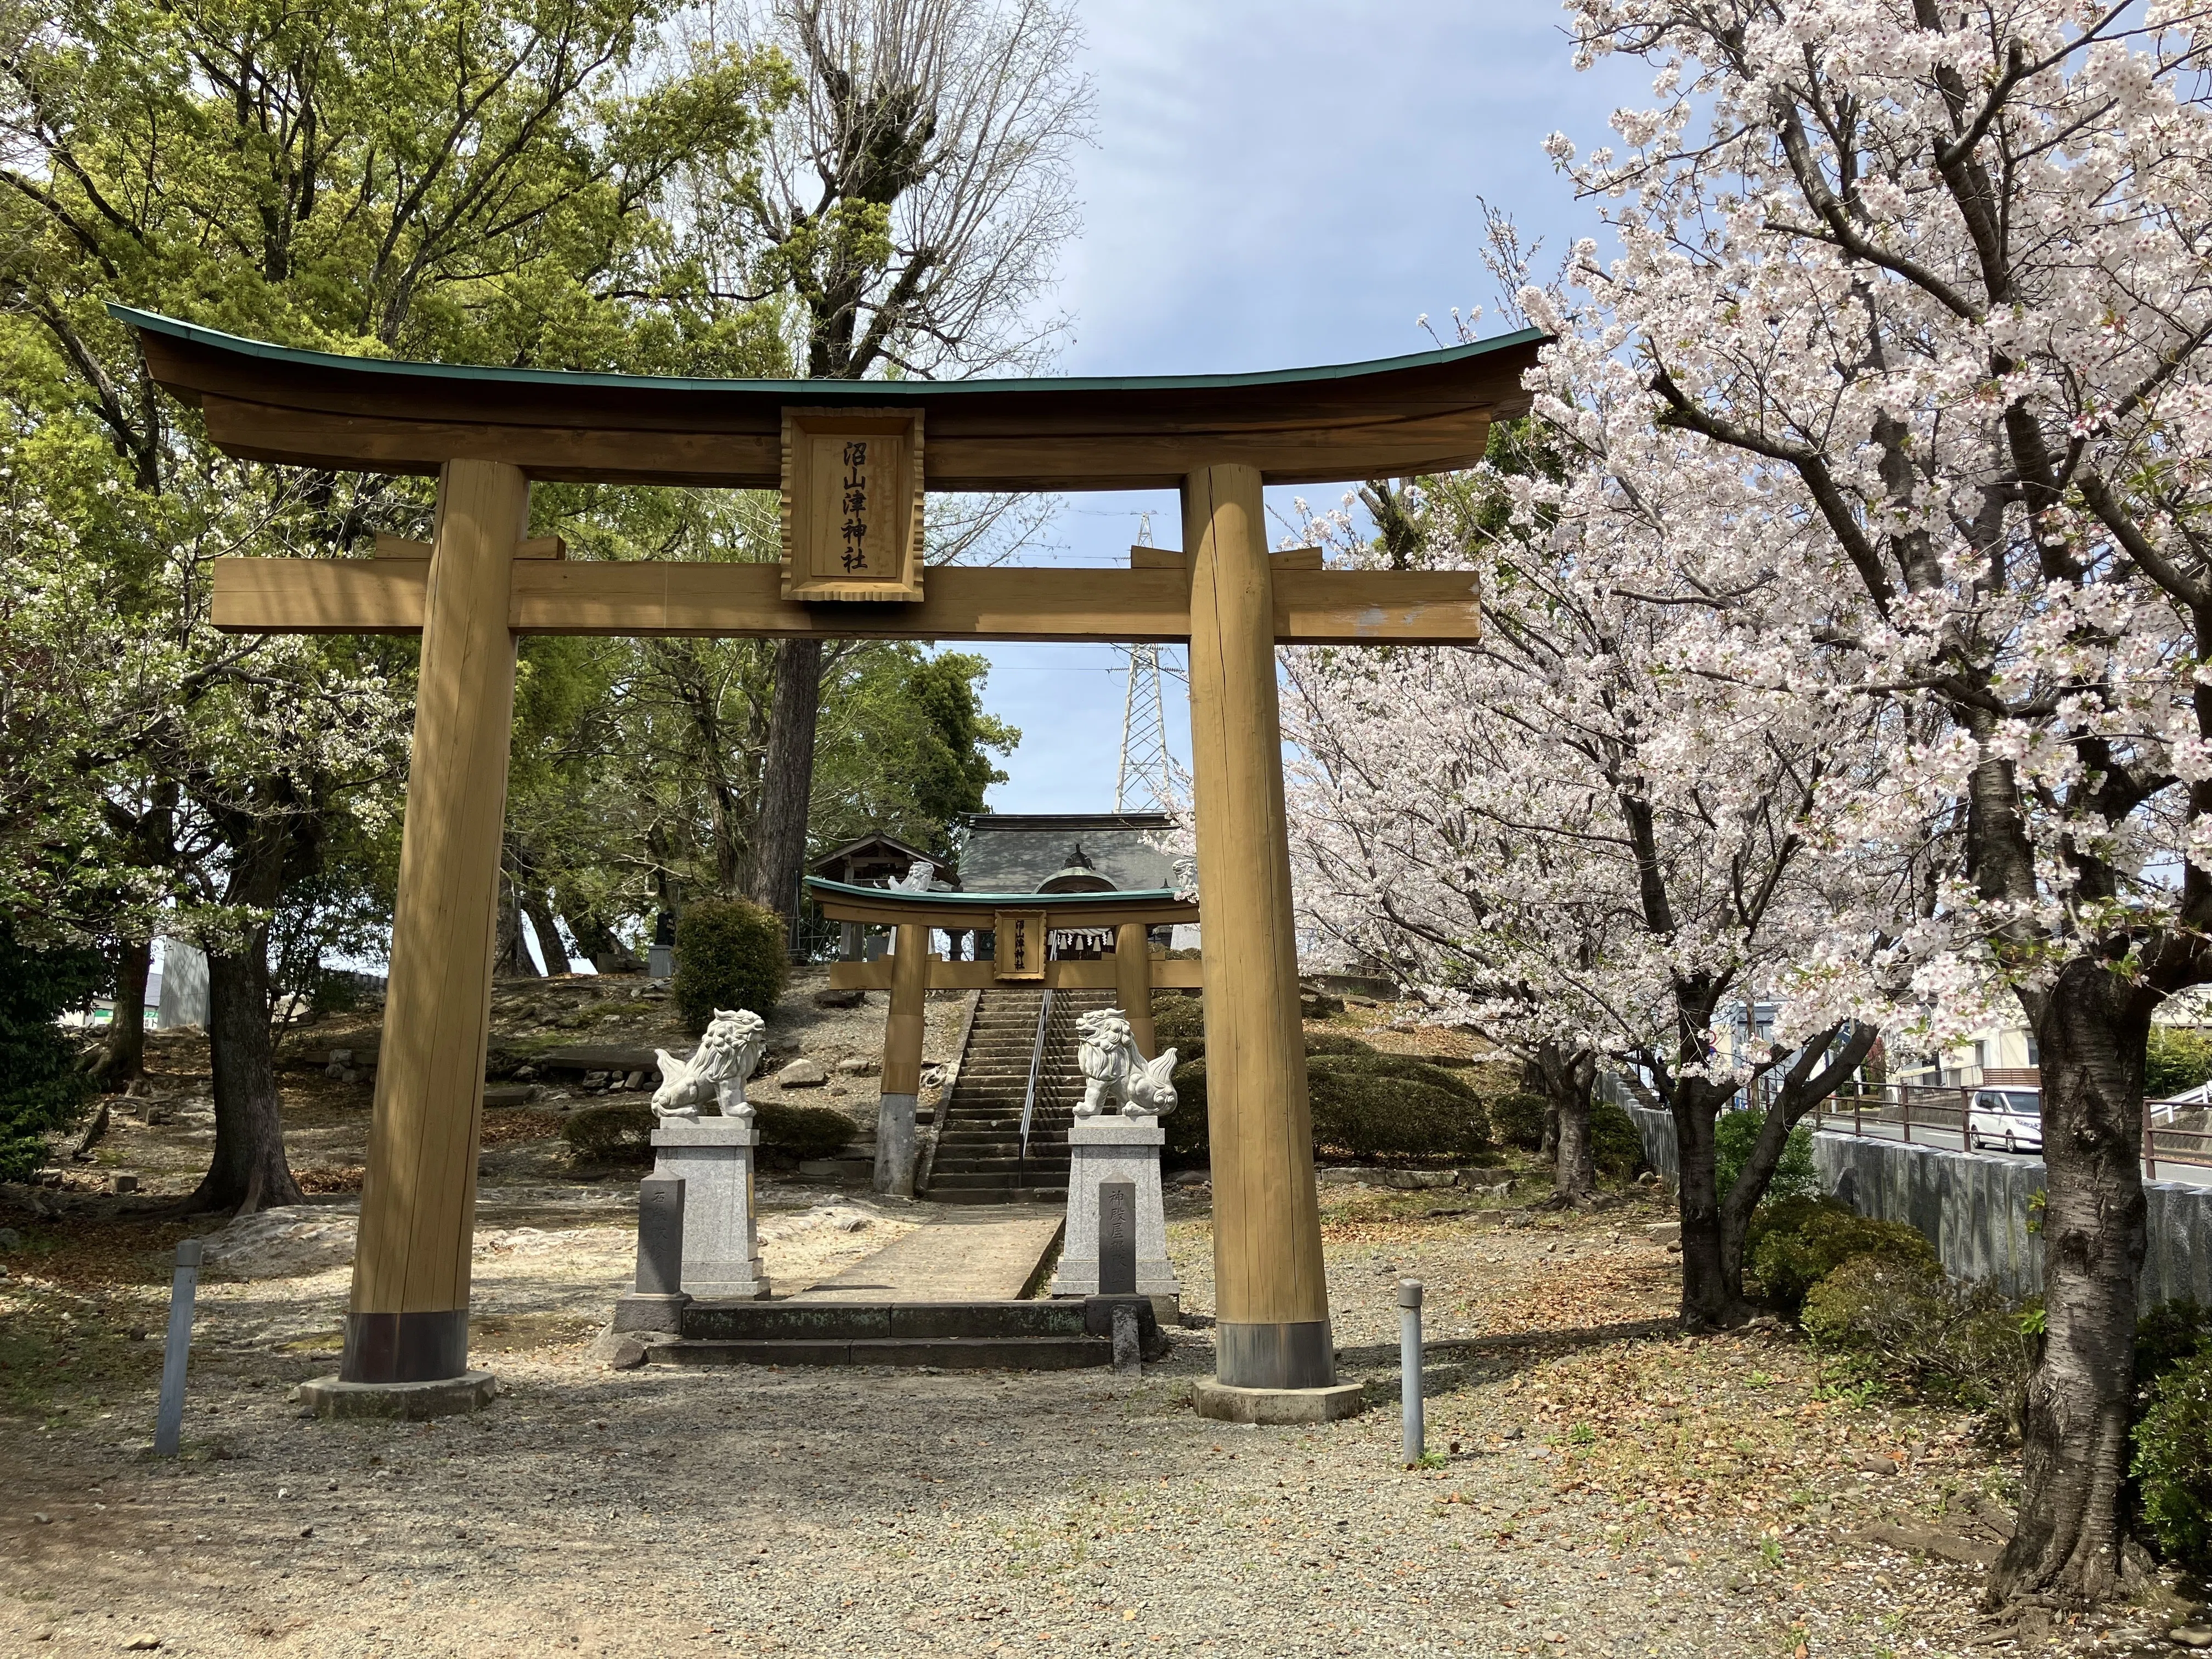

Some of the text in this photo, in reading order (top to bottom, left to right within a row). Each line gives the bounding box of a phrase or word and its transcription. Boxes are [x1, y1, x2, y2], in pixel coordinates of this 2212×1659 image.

[841, 442, 868, 573] 沼山津神社
[1014, 919, 1025, 970] 沼山津神社
